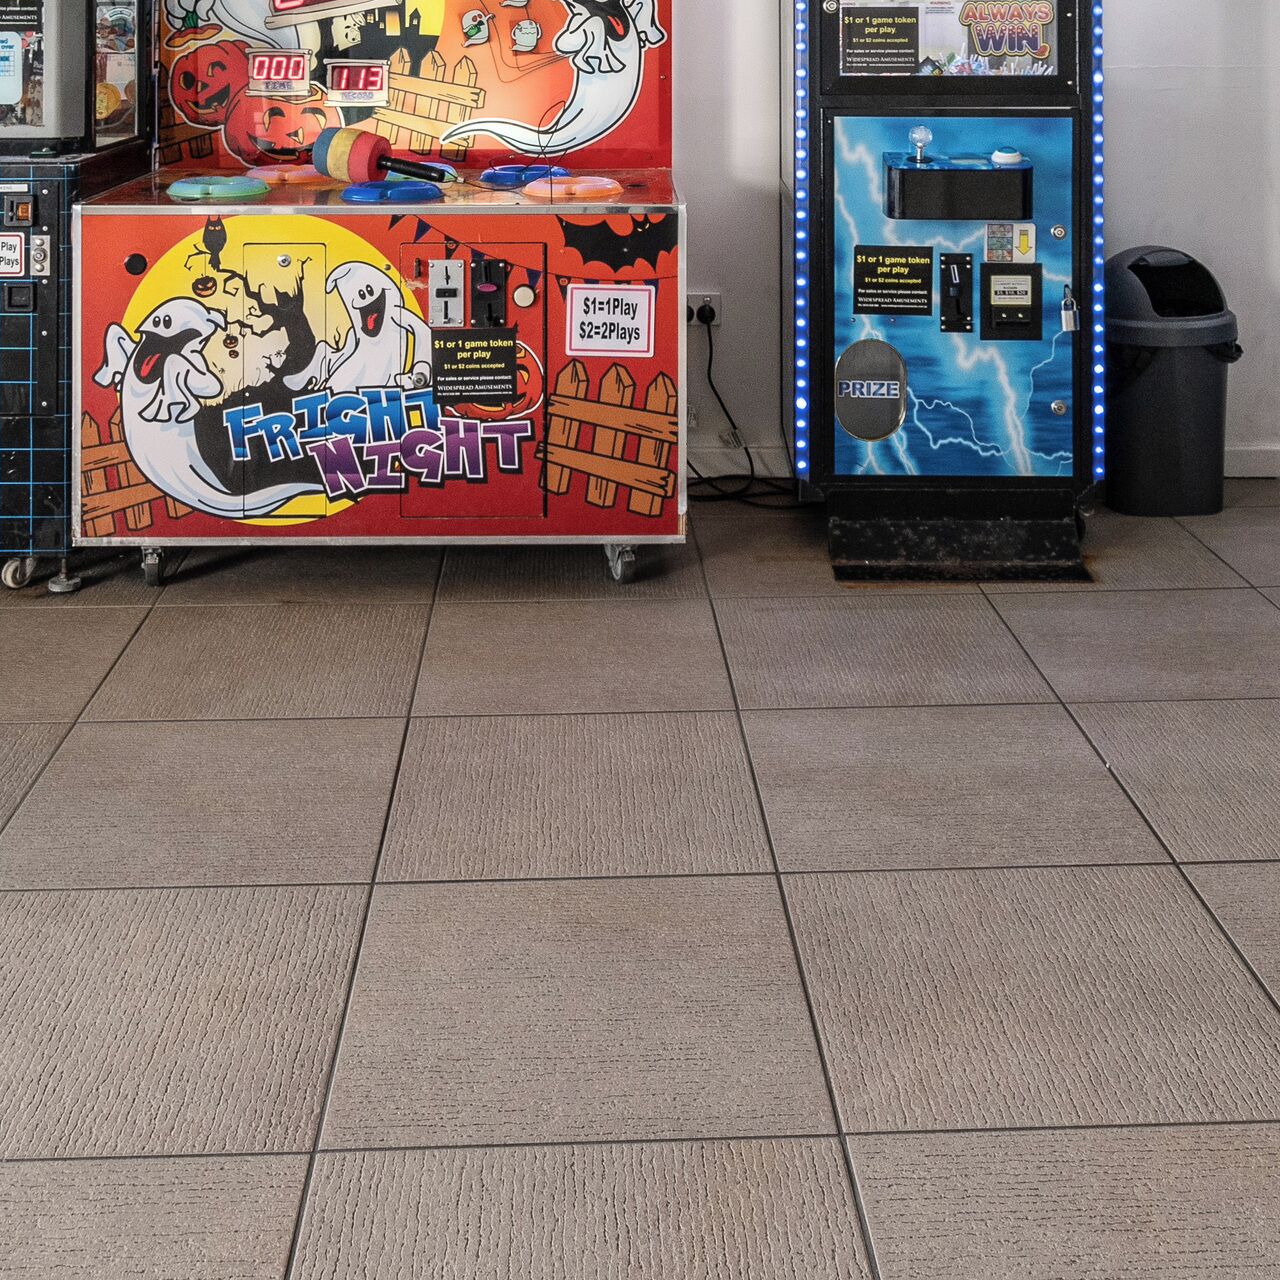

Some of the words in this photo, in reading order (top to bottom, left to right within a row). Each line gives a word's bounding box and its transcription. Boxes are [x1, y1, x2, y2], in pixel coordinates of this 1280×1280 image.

[961, 0, 1054, 23] ALWAYS
[872, 17, 892, 25] game
[895, 16, 917, 24] token
[880, 26, 896, 34] play
[972, 23, 1042, 56] WIN
[253, 57, 304, 80] 000
[341, 67, 383, 90] 113
[0, 241, 17, 253] Play
[857, 255, 866, 263] $1
[884, 256, 907, 265] game
[877, 266, 890, 274] per
[892, 266, 909, 275] play
[434, 340, 444, 349] $1
[464, 340, 488, 349] game
[489, 339, 514, 347] token
[457, 351, 471, 359] per
[473, 350, 491, 359] play
[837, 379, 900, 400] PRIZE
[308, 417, 532, 500] NIGHT
